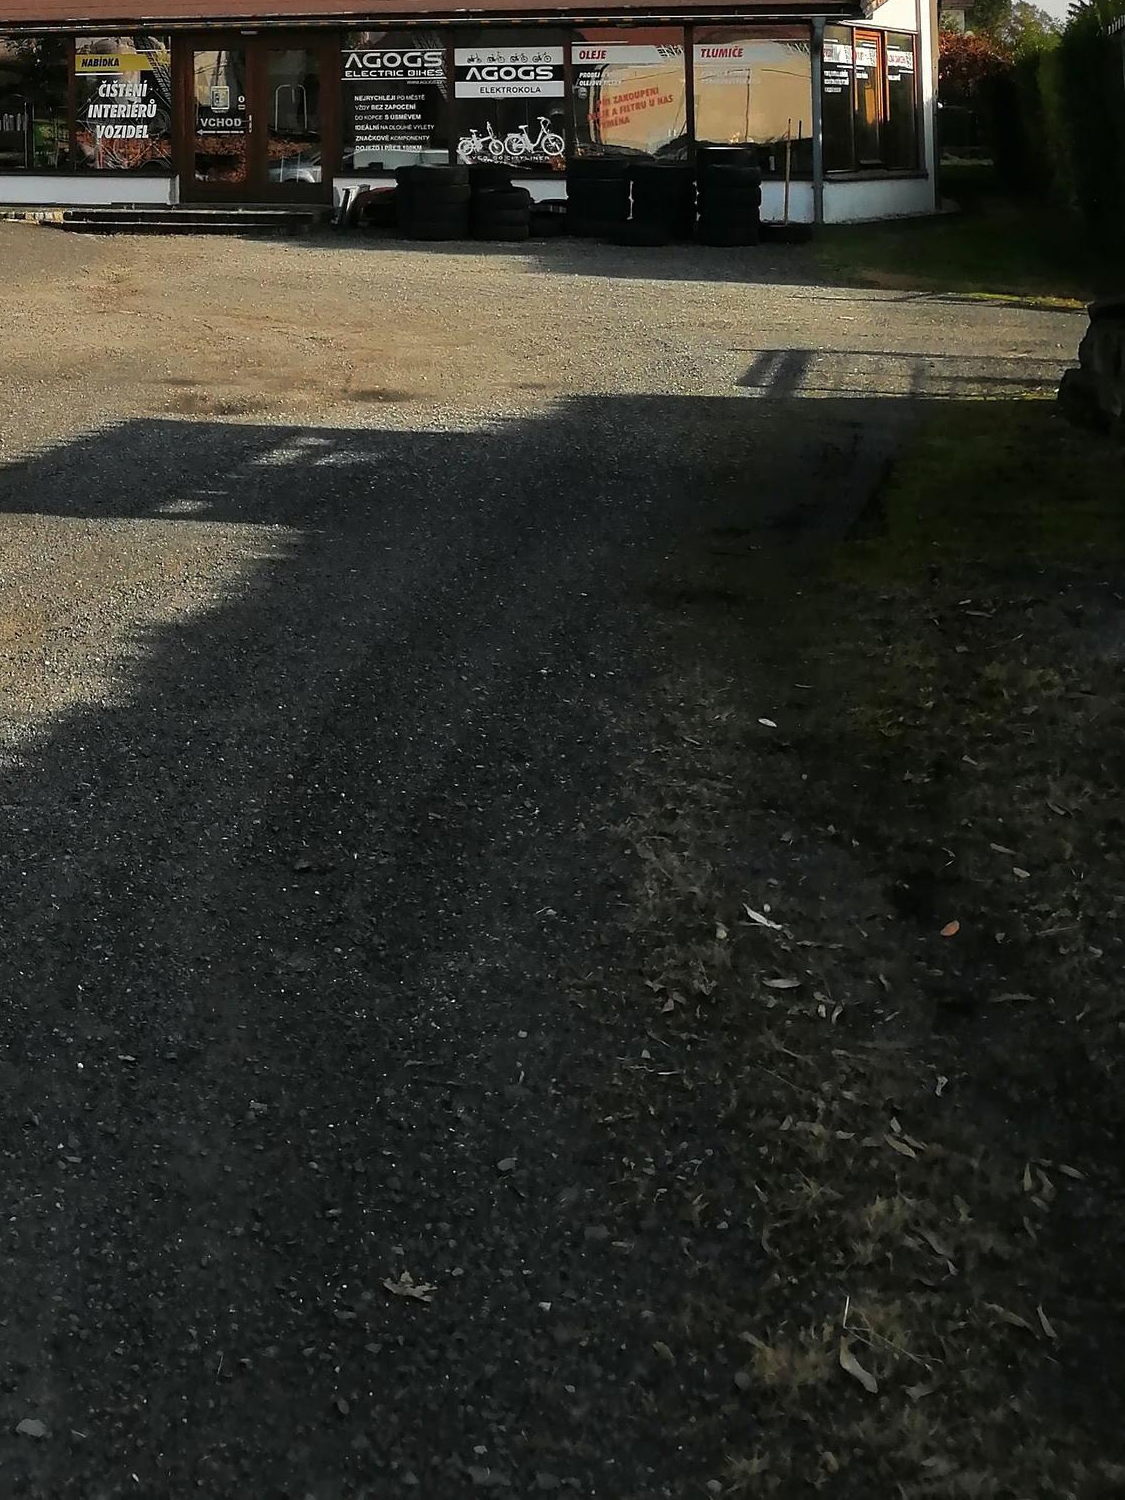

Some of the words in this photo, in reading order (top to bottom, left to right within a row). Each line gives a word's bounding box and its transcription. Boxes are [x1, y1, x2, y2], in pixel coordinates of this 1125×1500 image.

[579, 50, 607, 60] OLEJE
[701, 46, 744, 58] TLUMIČE
[81, 56, 120, 67] NABÍDKA
[345, 51, 442, 68] AGOGS
[407, 69, 443, 77] BIKES
[465, 66, 554, 80] AGOGS
[98, 80, 148, 98] ČIŠTĚNÍ
[87, 99, 157, 118] INTERIÉRŮ
[612, 107, 618, 116] A
[620, 100, 647, 114] FILTRU
[649, 99, 655, 107] U
[200, 117, 242, 127] VCHOD
[95, 125, 149, 139] VOZIDEL
